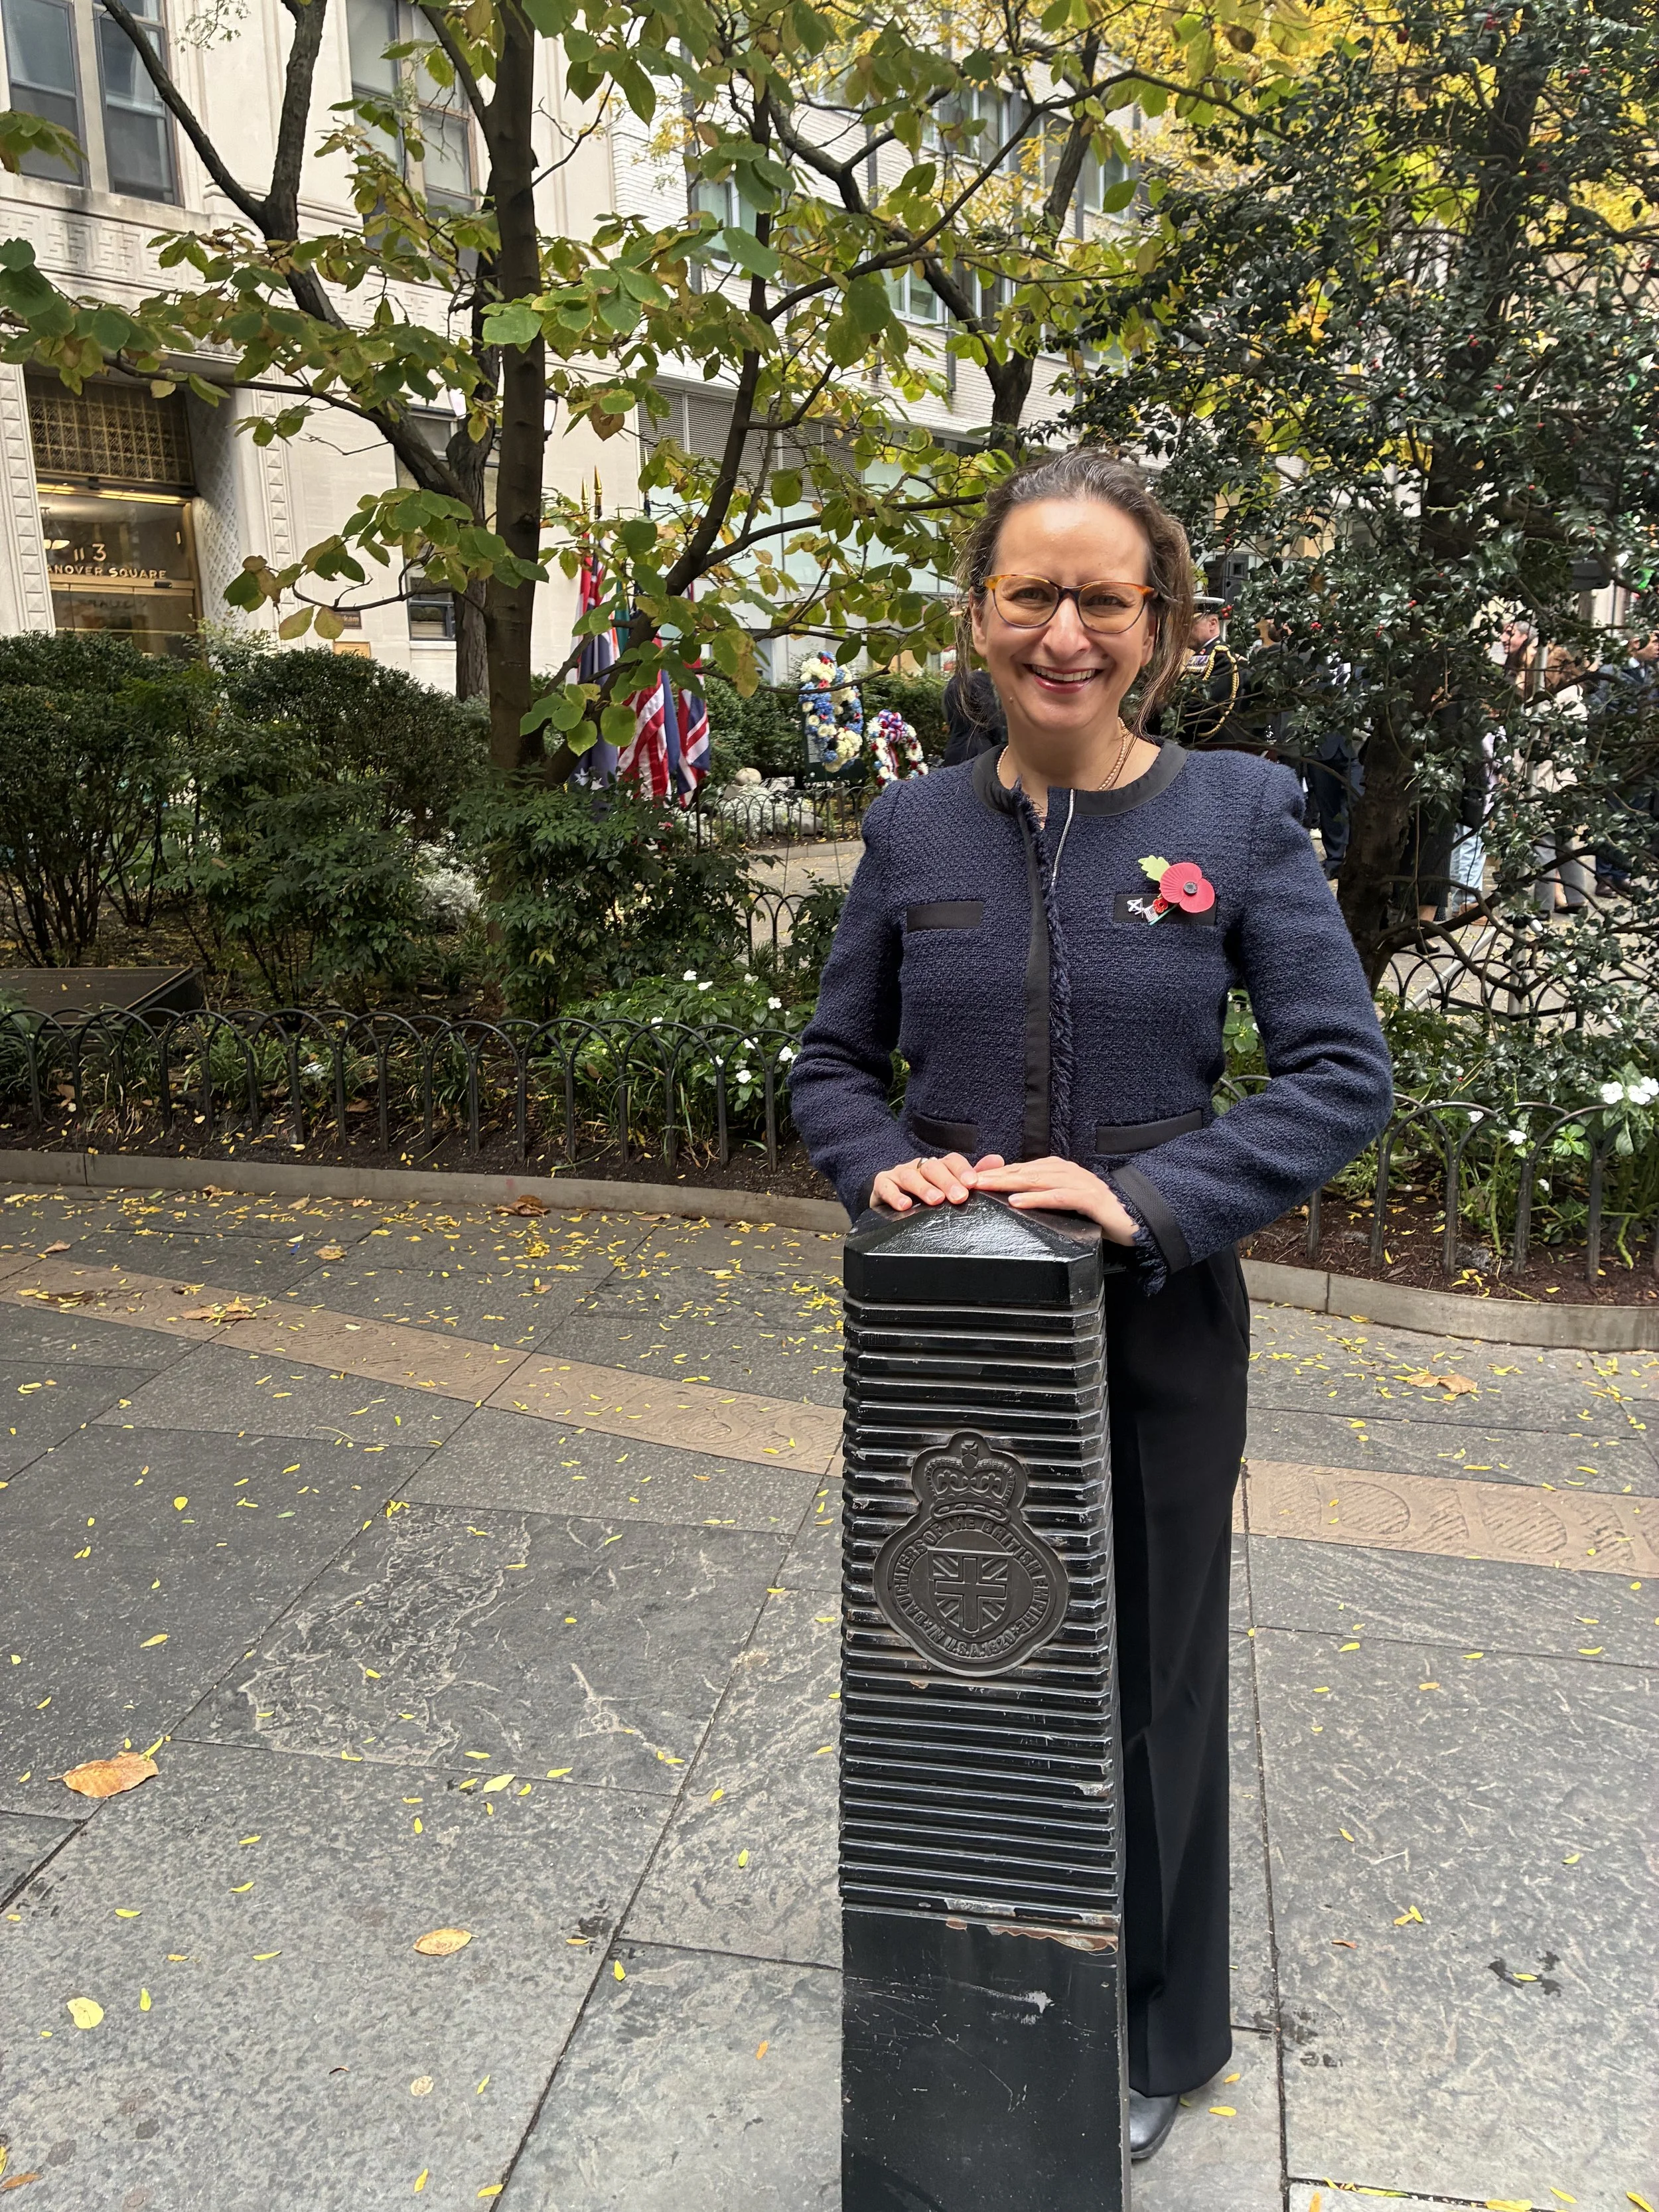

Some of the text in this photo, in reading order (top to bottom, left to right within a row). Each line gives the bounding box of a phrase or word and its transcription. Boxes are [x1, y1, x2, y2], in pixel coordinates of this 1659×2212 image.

[92, 543, 107, 561] 3
[46, 564, 167, 579] ANOVER SQUARE
[893, 1514, 1049, 1633] DAUGHTERS OF THE BRITISH EMPIRE
[925, 1623, 946, 1643] IN
